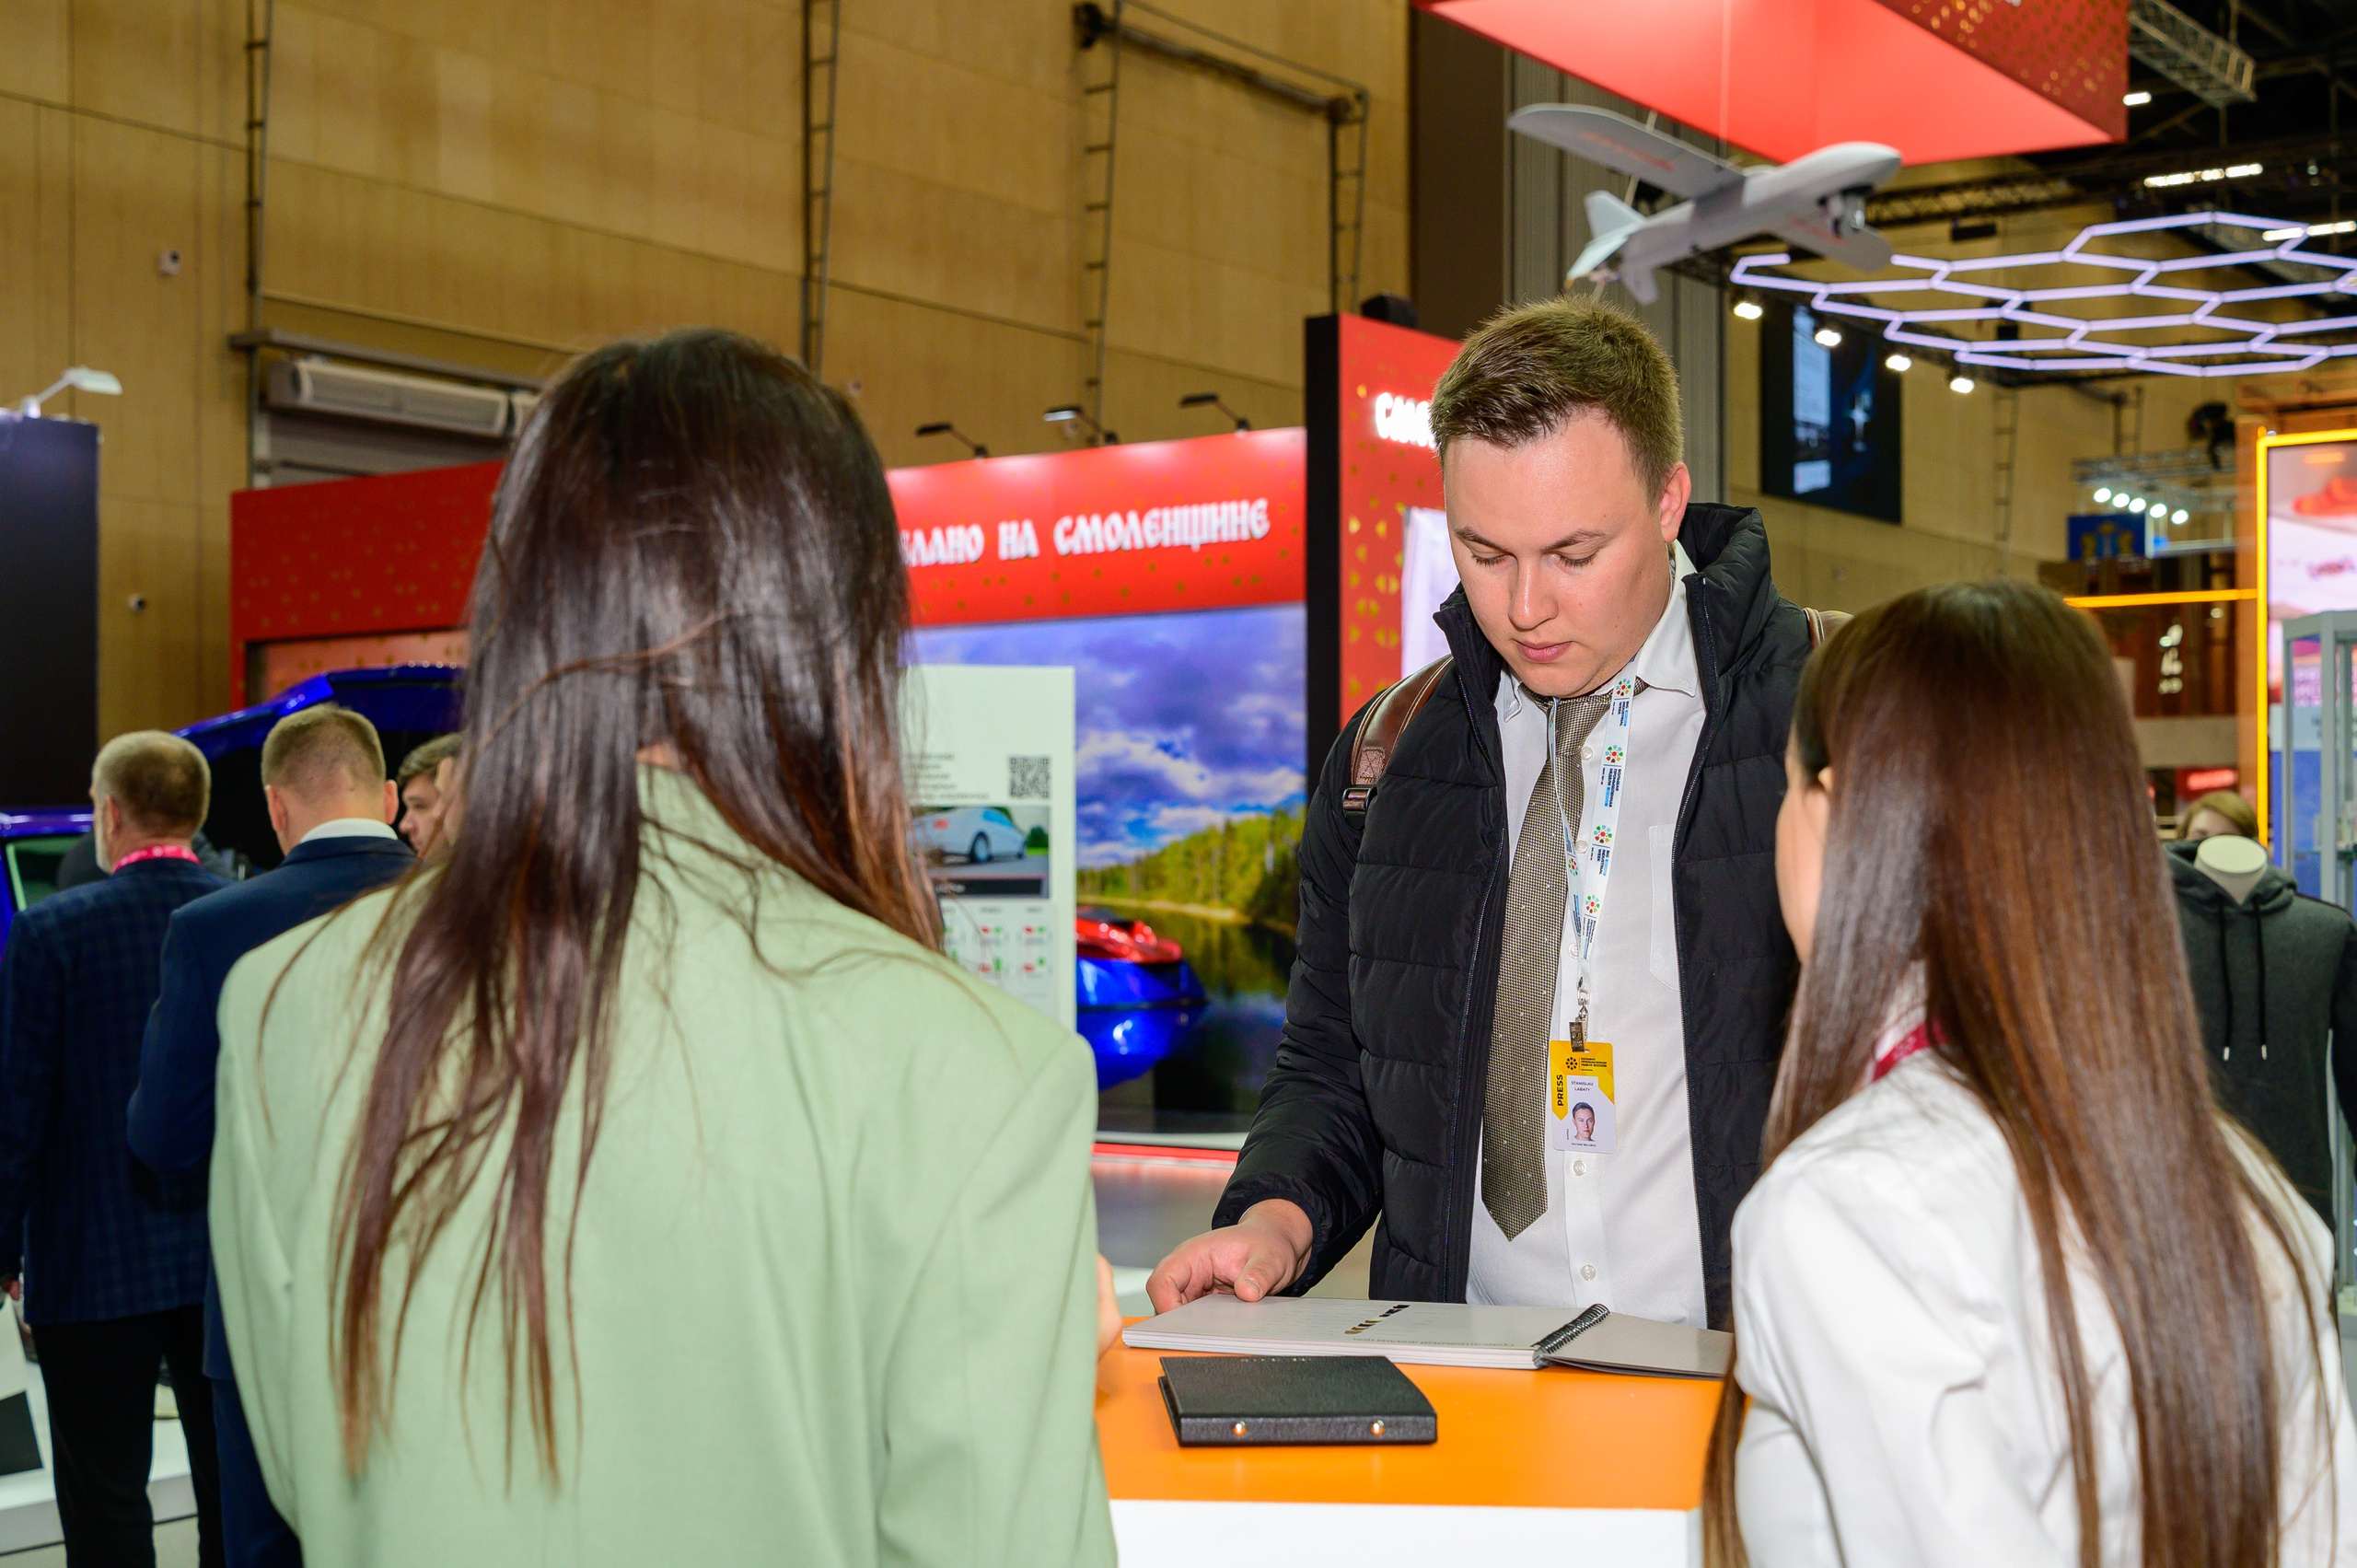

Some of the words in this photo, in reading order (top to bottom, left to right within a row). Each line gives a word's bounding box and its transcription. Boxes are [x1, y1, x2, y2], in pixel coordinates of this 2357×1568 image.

[1376, 392, 1436, 449] СМО
[997, 519, 1040, 561] НА
[1052, 497, 1271, 557] СМОЛЕНЩИНЕ
[1556, 1074, 1564, 1107] PRESS
